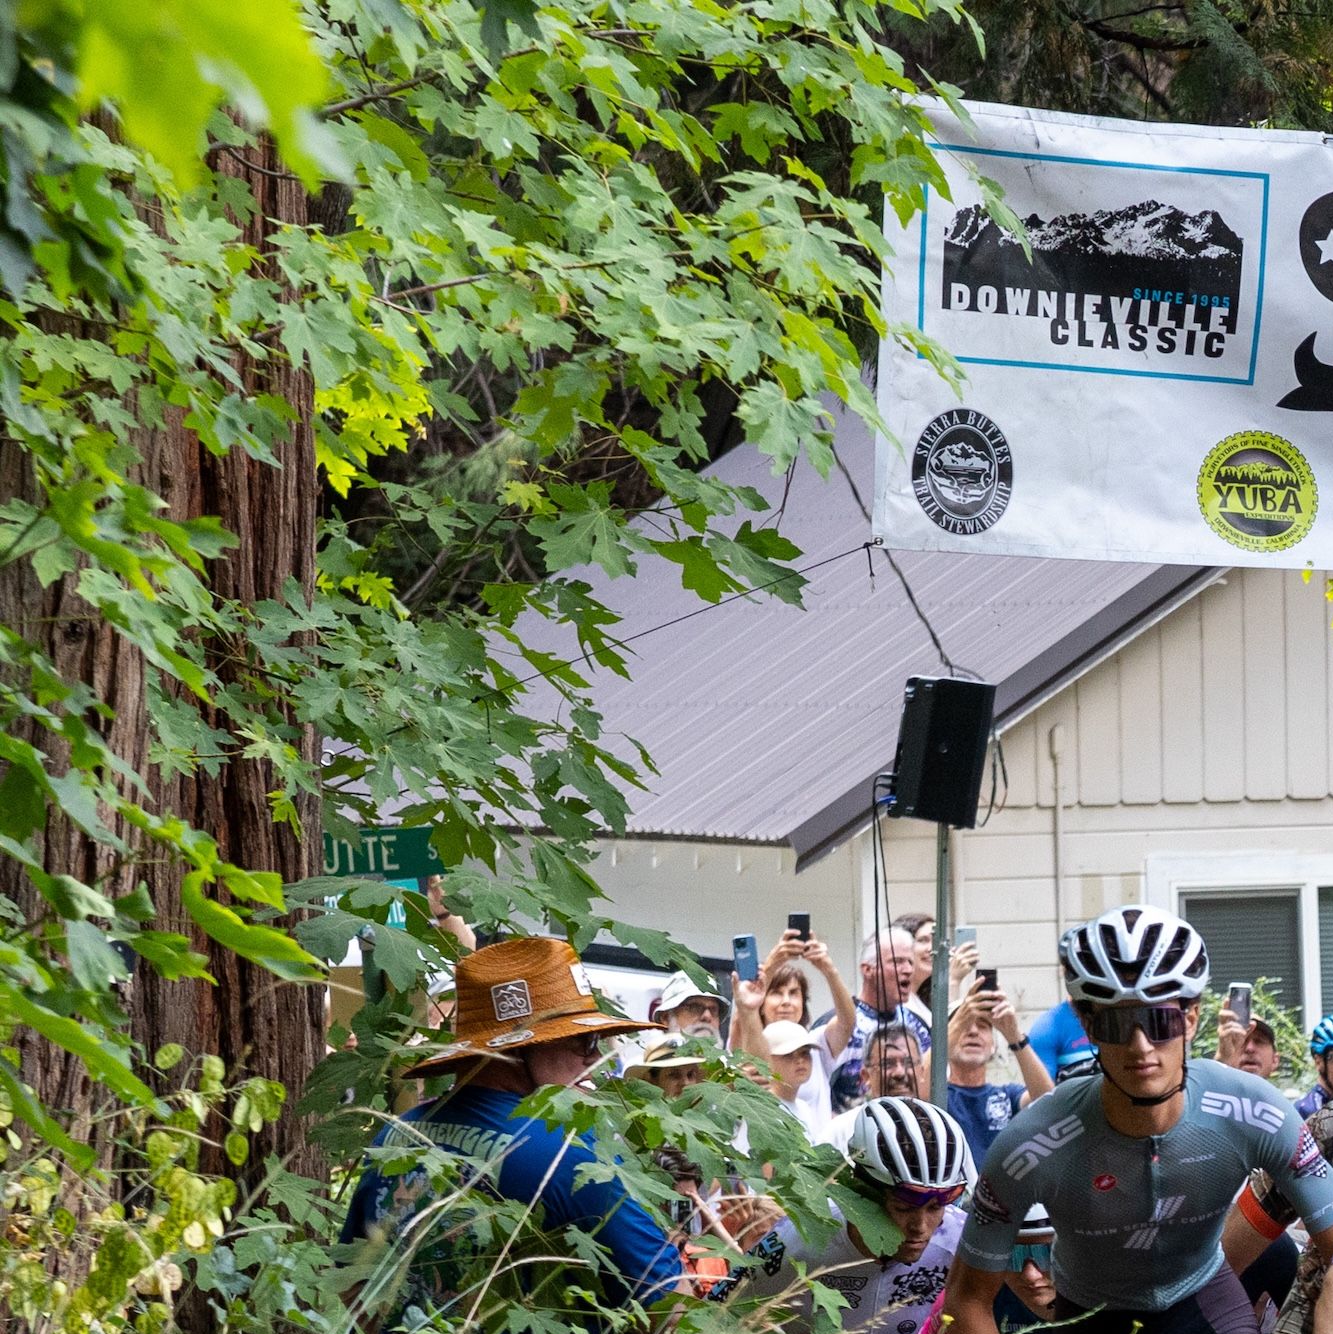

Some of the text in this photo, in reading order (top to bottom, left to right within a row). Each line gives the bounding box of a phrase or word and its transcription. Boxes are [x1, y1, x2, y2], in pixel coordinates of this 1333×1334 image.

[950, 282, 1229, 334] DOWNIEVILLE
[1133, 287, 1231, 309] SINCE 1995
[1049, 317, 1226, 359] CLASSIC
[916, 410, 1011, 465] SIERRA BUTTES
[1206, 439, 1307, 485] PURVEYORS OF FINE SINGLETRACK
[912, 475, 1012, 535] TRAIL STEWARDSHIP
[1212, 484, 1303, 515] YUBA
[1123, 1219, 1177, 1233] SERVE
